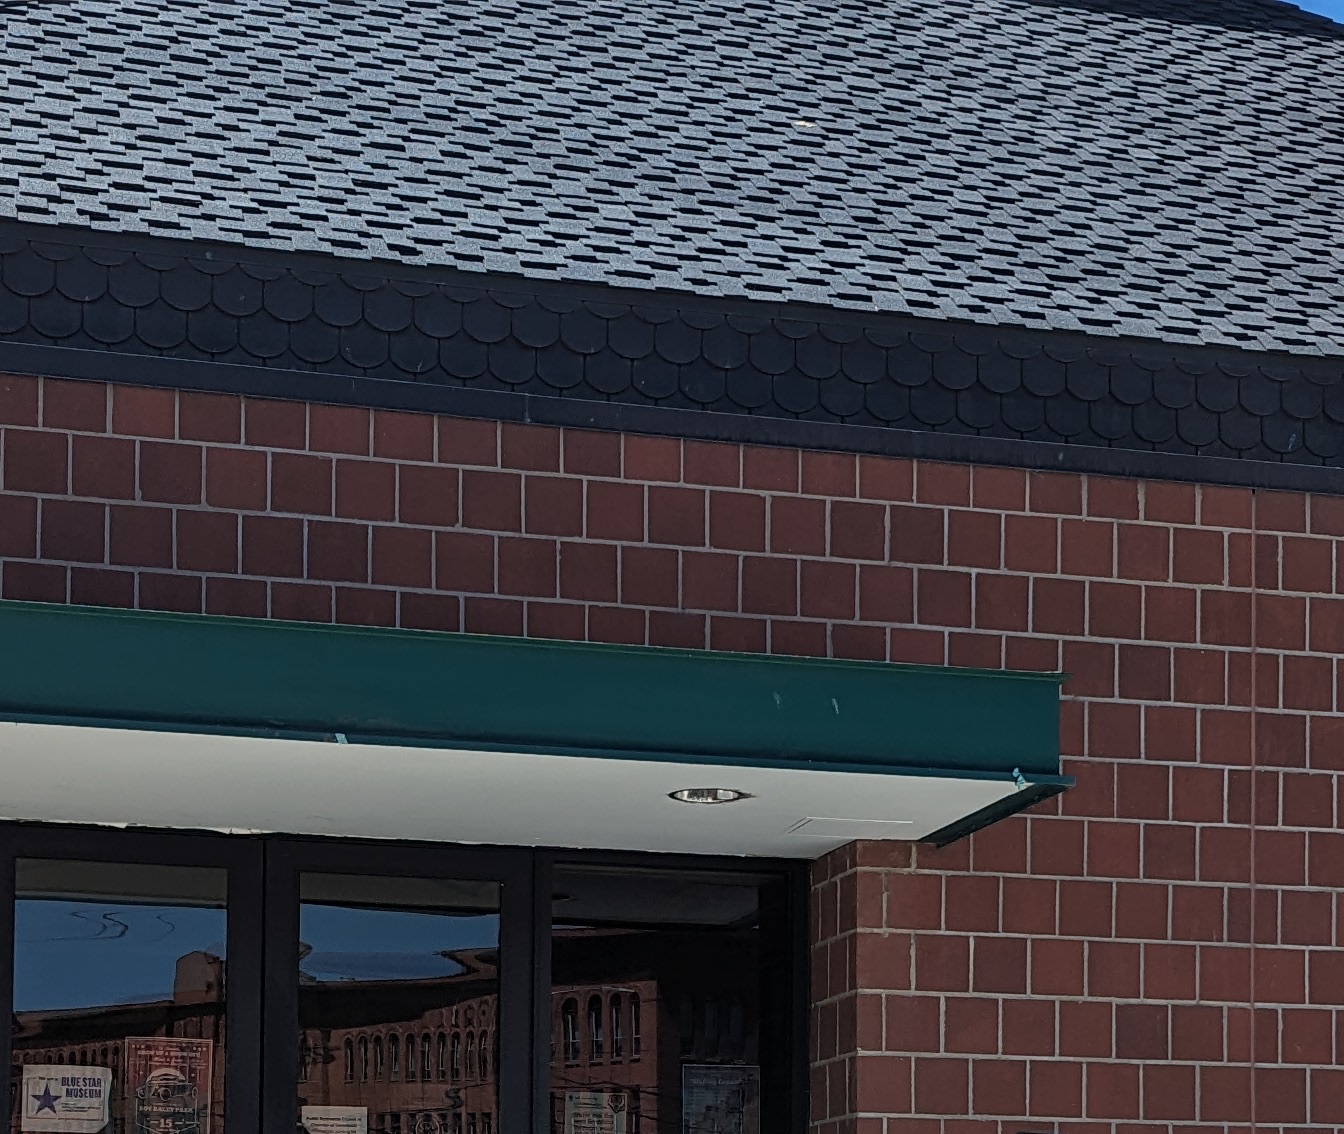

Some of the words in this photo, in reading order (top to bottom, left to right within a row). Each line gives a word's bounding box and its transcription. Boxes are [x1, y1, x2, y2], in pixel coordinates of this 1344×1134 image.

[61, 1076, 81, 1087] BLUE
[82, 1077, 102, 1088] STAR
[65, 1087, 102, 1099] MUSEUM
[159, 1118, 173, 1128] 15
